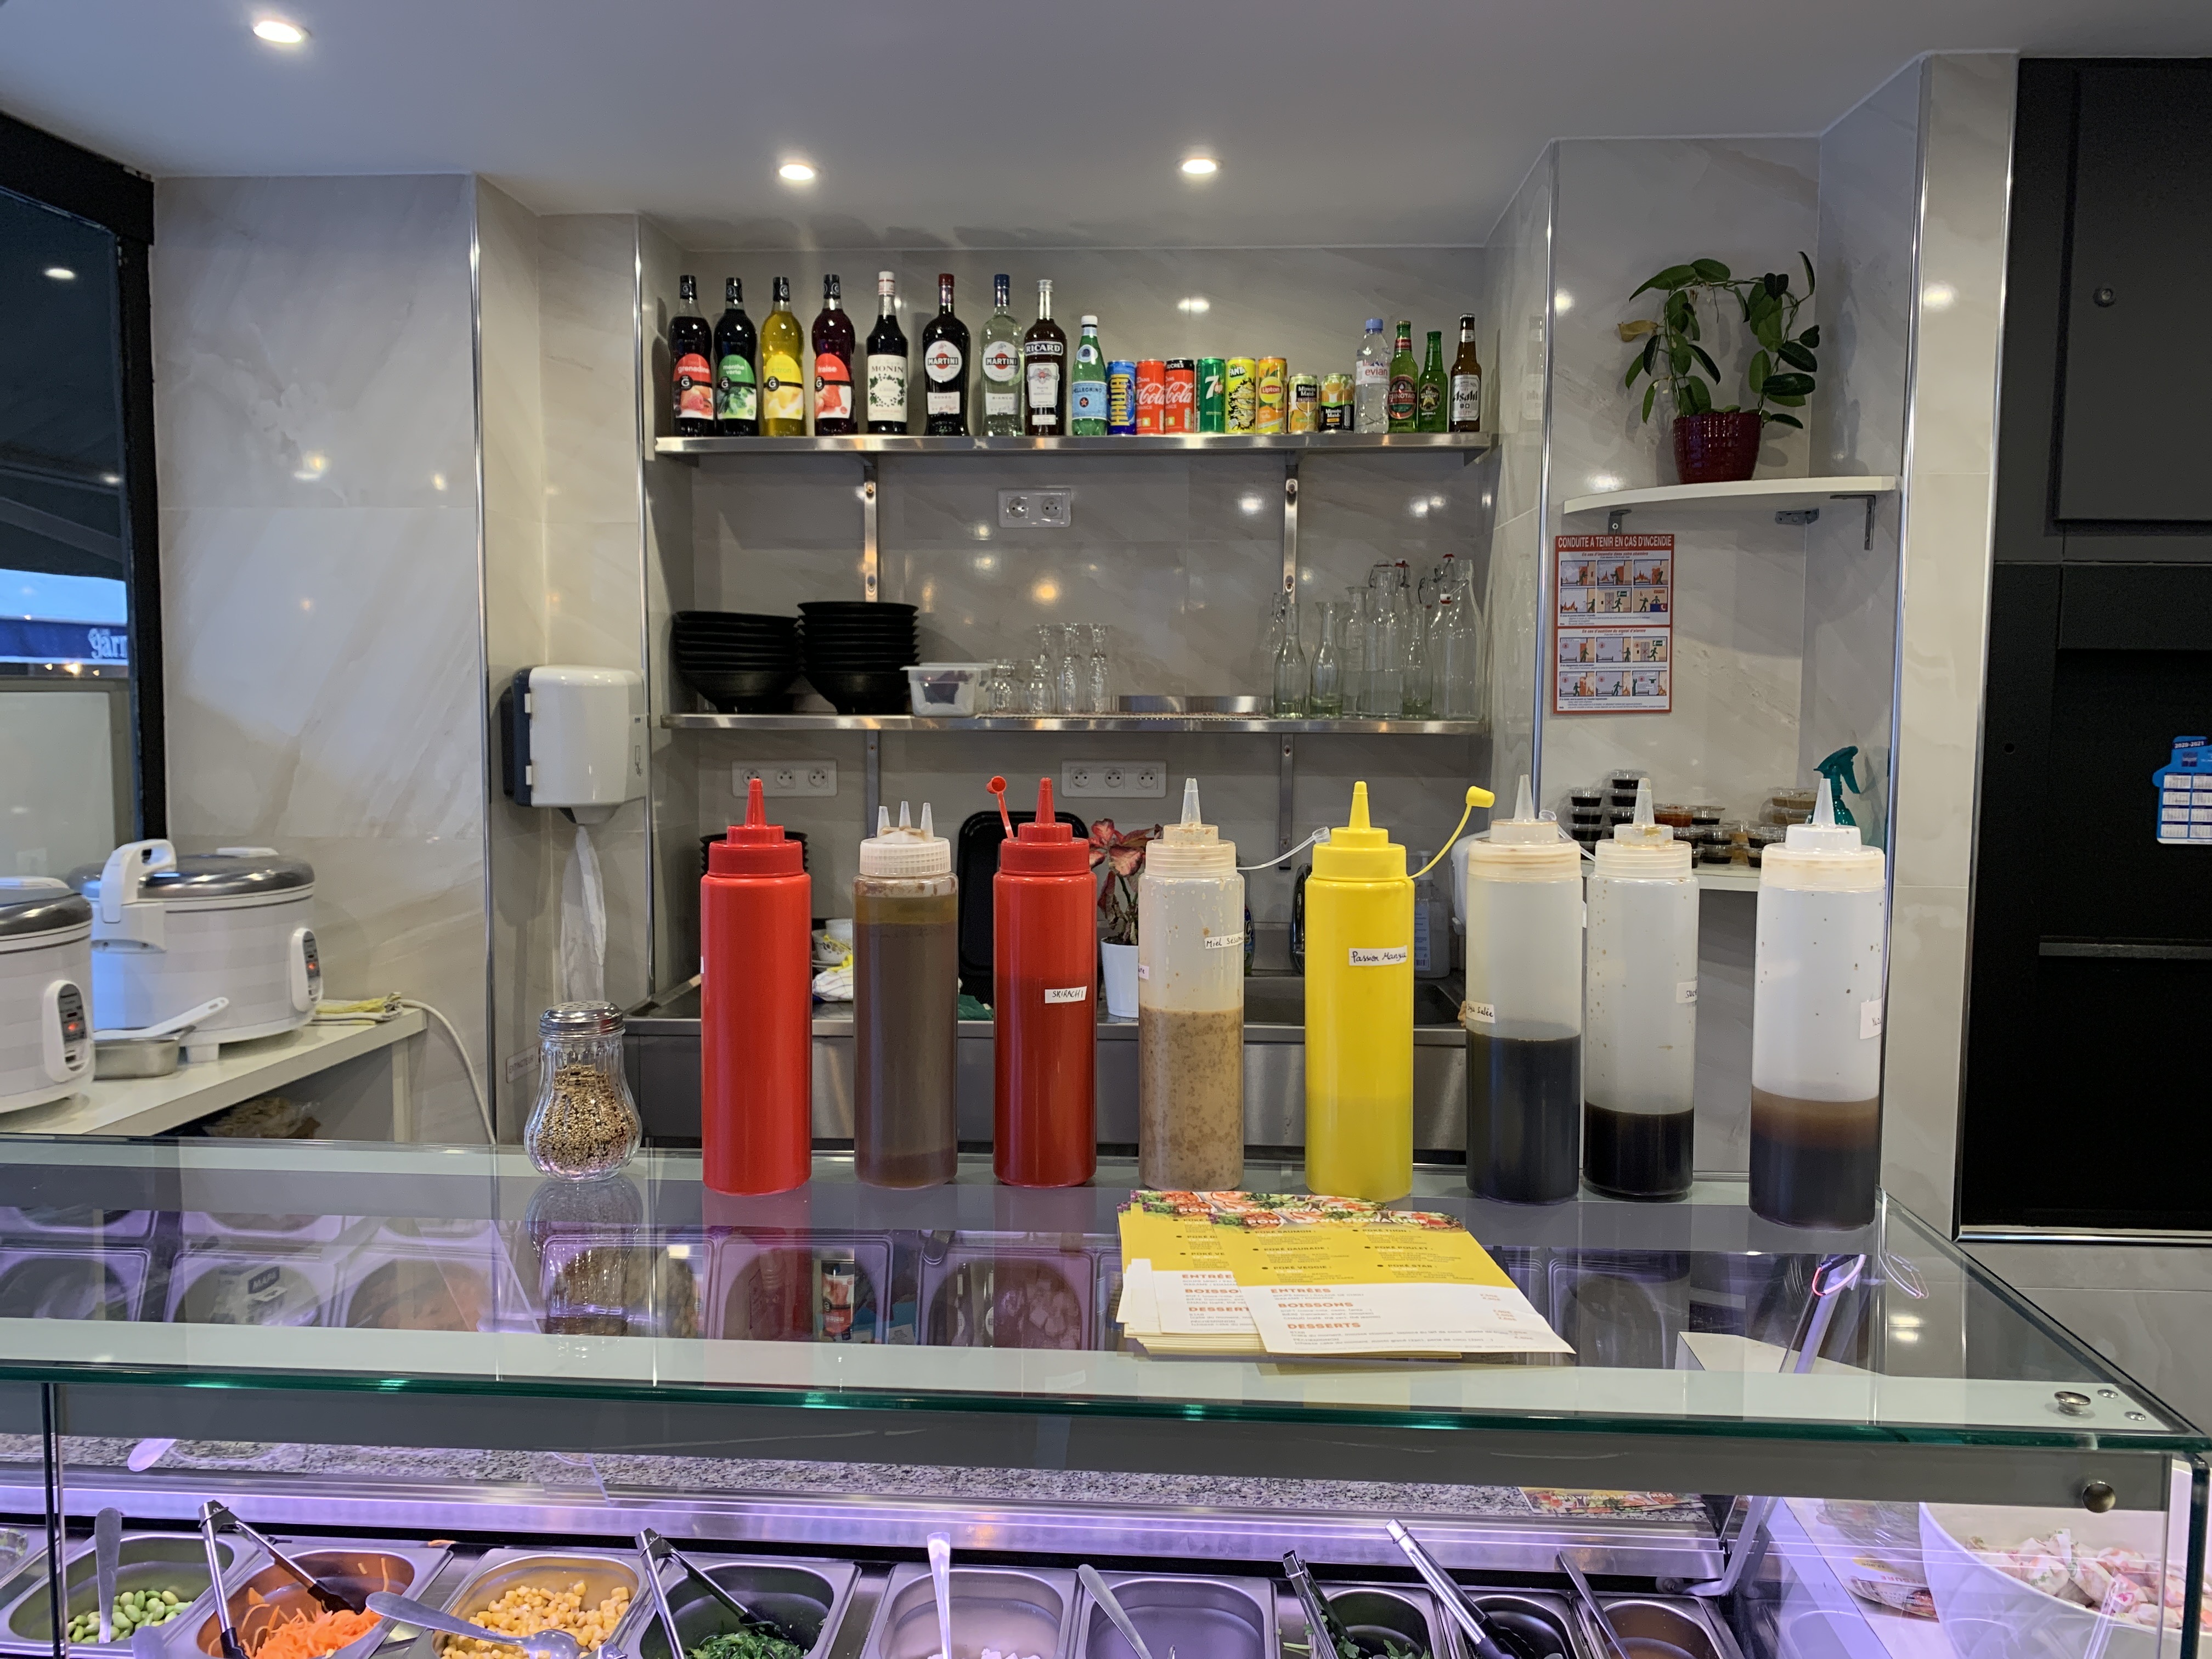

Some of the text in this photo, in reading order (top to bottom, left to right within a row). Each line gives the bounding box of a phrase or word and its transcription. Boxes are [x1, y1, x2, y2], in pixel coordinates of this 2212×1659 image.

[1026, 344, 1060, 352] RICARD
[678, 365, 710, 374] grenadine
[771, 364, 792, 374] citron
[871, 365, 904, 373] MONIN
[1228, 366, 1246, 376] FANTA
[1365, 367, 1388, 377] evian
[1452, 390, 1479, 402] Asahi
[1559, 535, 1672, 548] CONDUITE A TENIR EN CAS D'INCENDIE
[2174, 741, 2204, 749] 2020-2021
[1206, 937, 1222, 947] Miel
[1351, 951, 1379, 963] Passion
